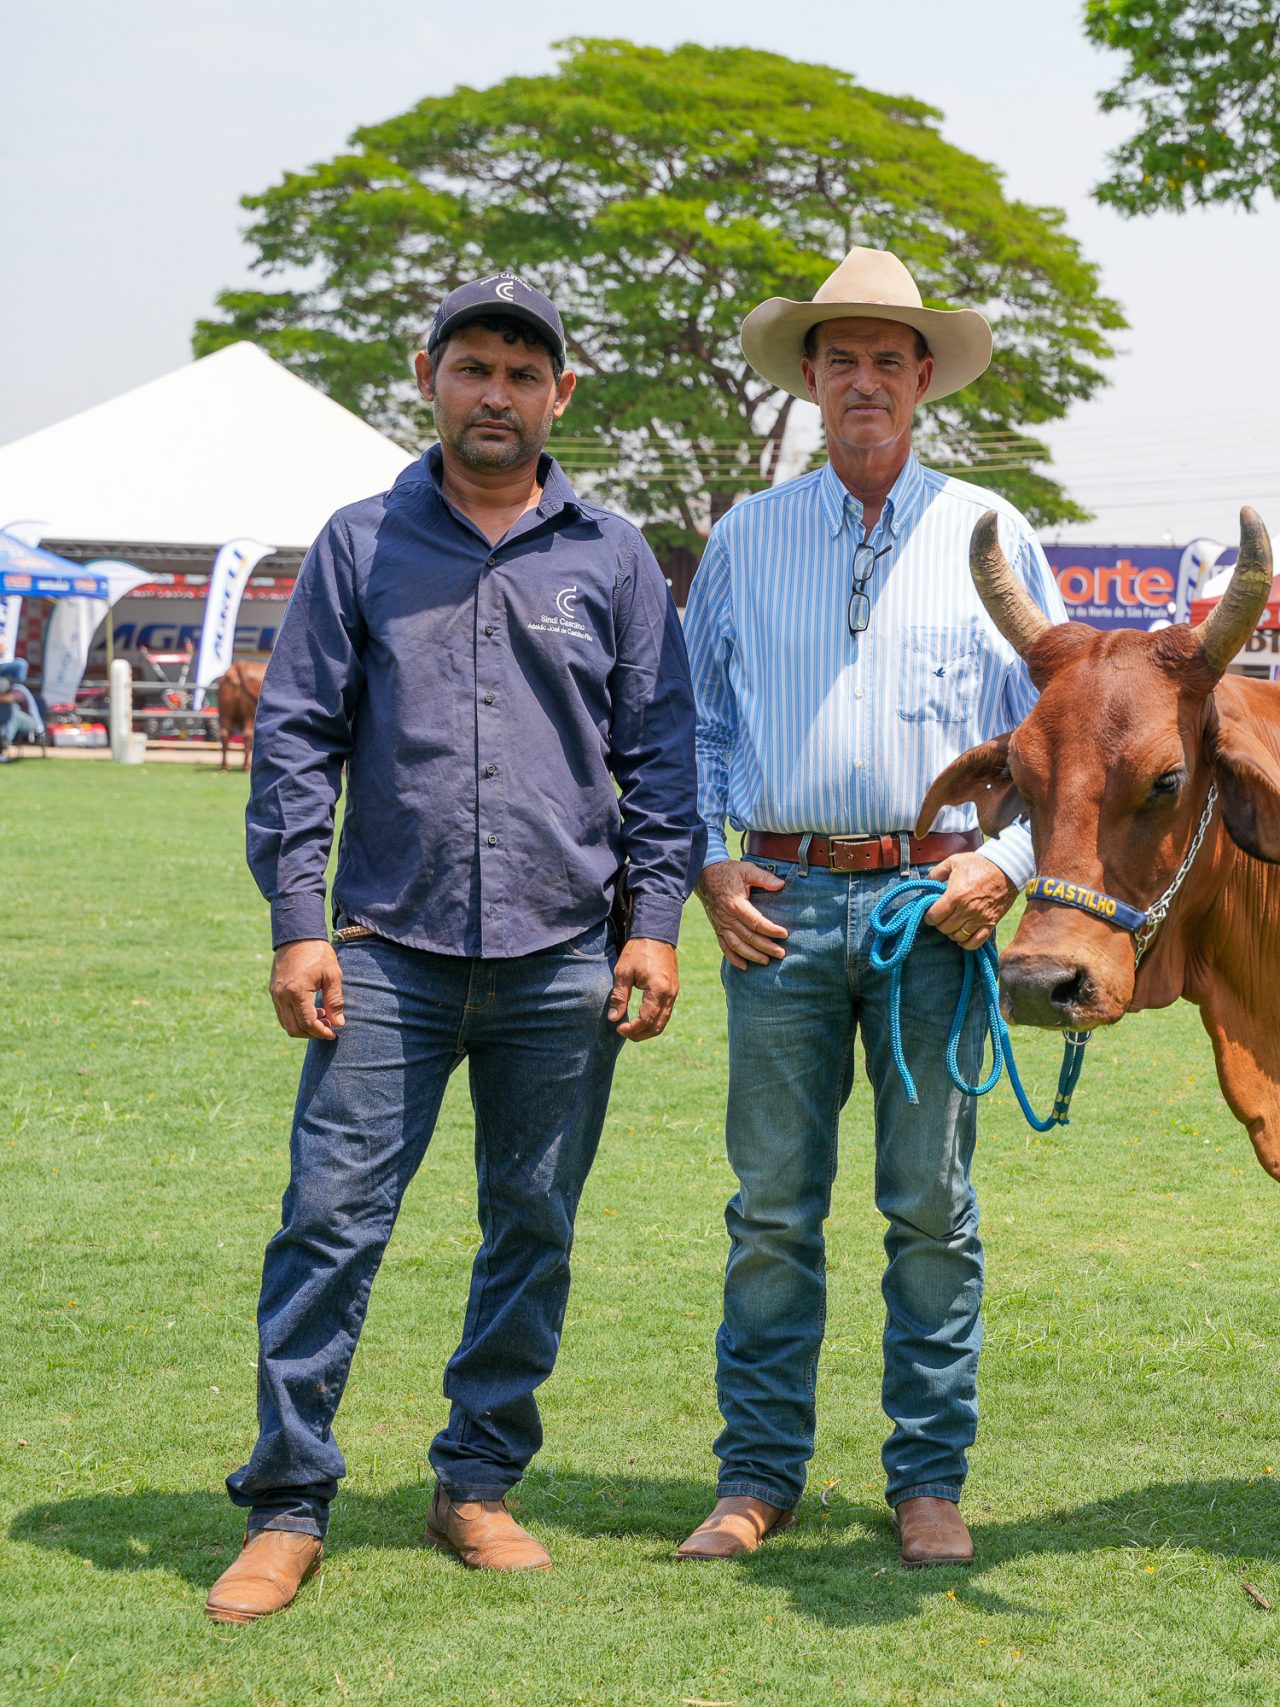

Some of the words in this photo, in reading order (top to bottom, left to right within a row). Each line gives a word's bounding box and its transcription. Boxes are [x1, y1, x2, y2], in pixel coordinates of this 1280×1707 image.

[1051, 560, 1175, 606] orte
[540, 614, 558, 624] Sindi
[1042, 879, 1117, 918] CASTILHO
